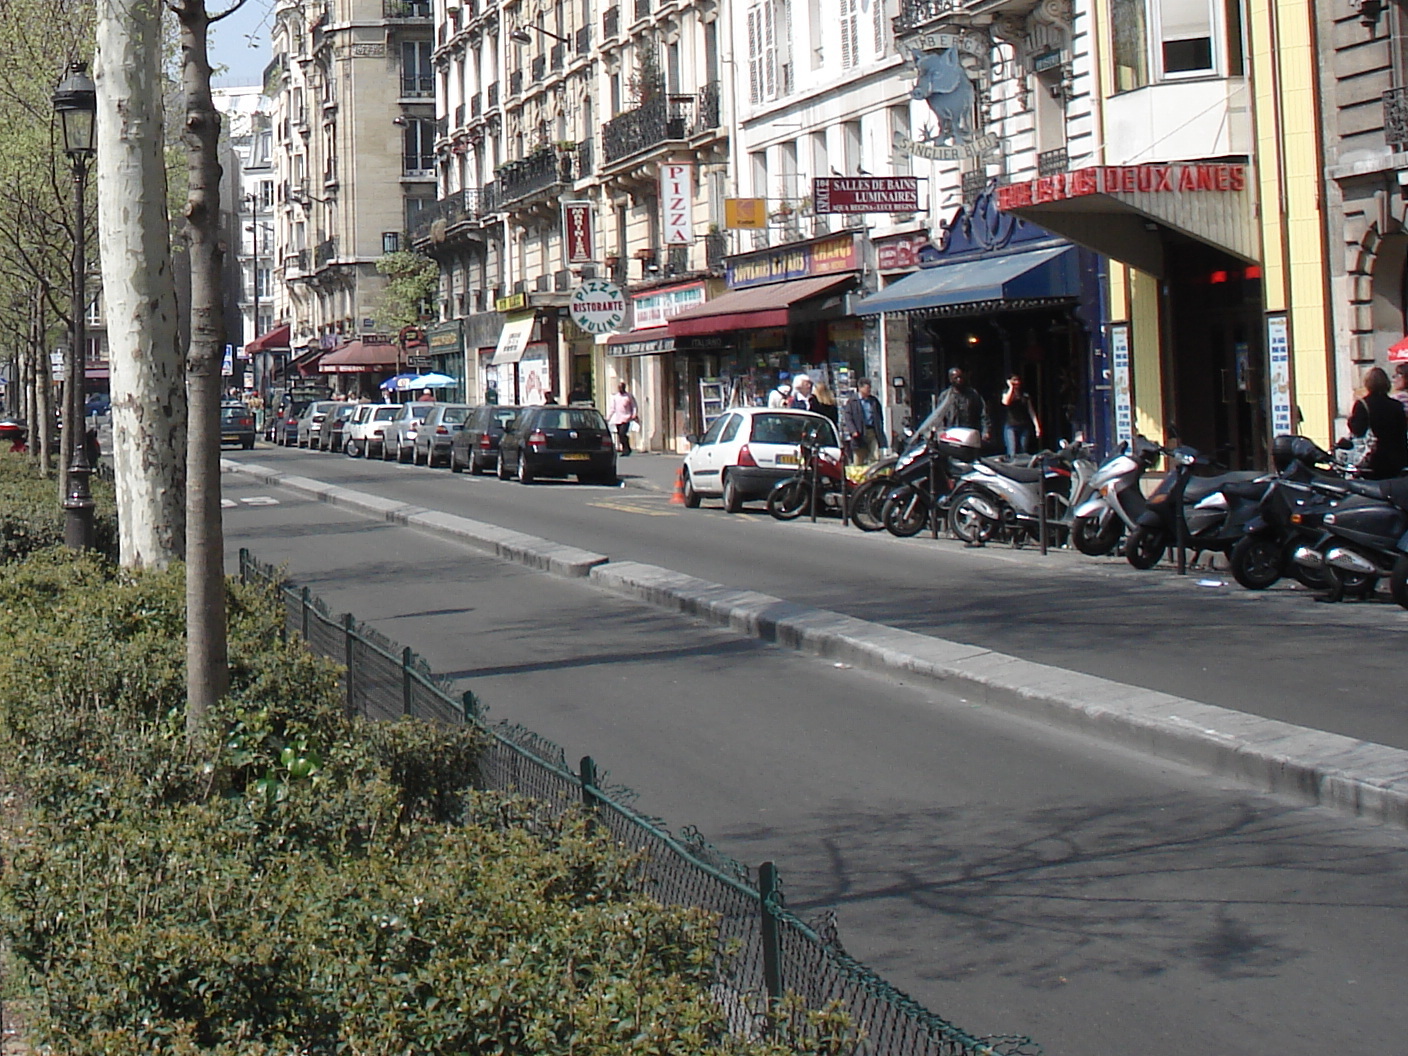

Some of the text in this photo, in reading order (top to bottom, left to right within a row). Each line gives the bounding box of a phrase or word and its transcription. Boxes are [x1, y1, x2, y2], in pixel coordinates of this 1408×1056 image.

[899, 137, 993, 160] SANGLIER BLEU
[833, 179, 916, 191] SALLES DE BAINS
[1104, 165, 1173, 193] DEUX
[1179, 164, 1247, 192] ANES
[668, 166, 688, 242] PIZZA
[855, 191, 917, 203] LUMINAIRES
[575, 282, 618, 302] PIZZA
[573, 301, 623, 313] RISTORANTE
[578, 313, 622, 332] MULINO
